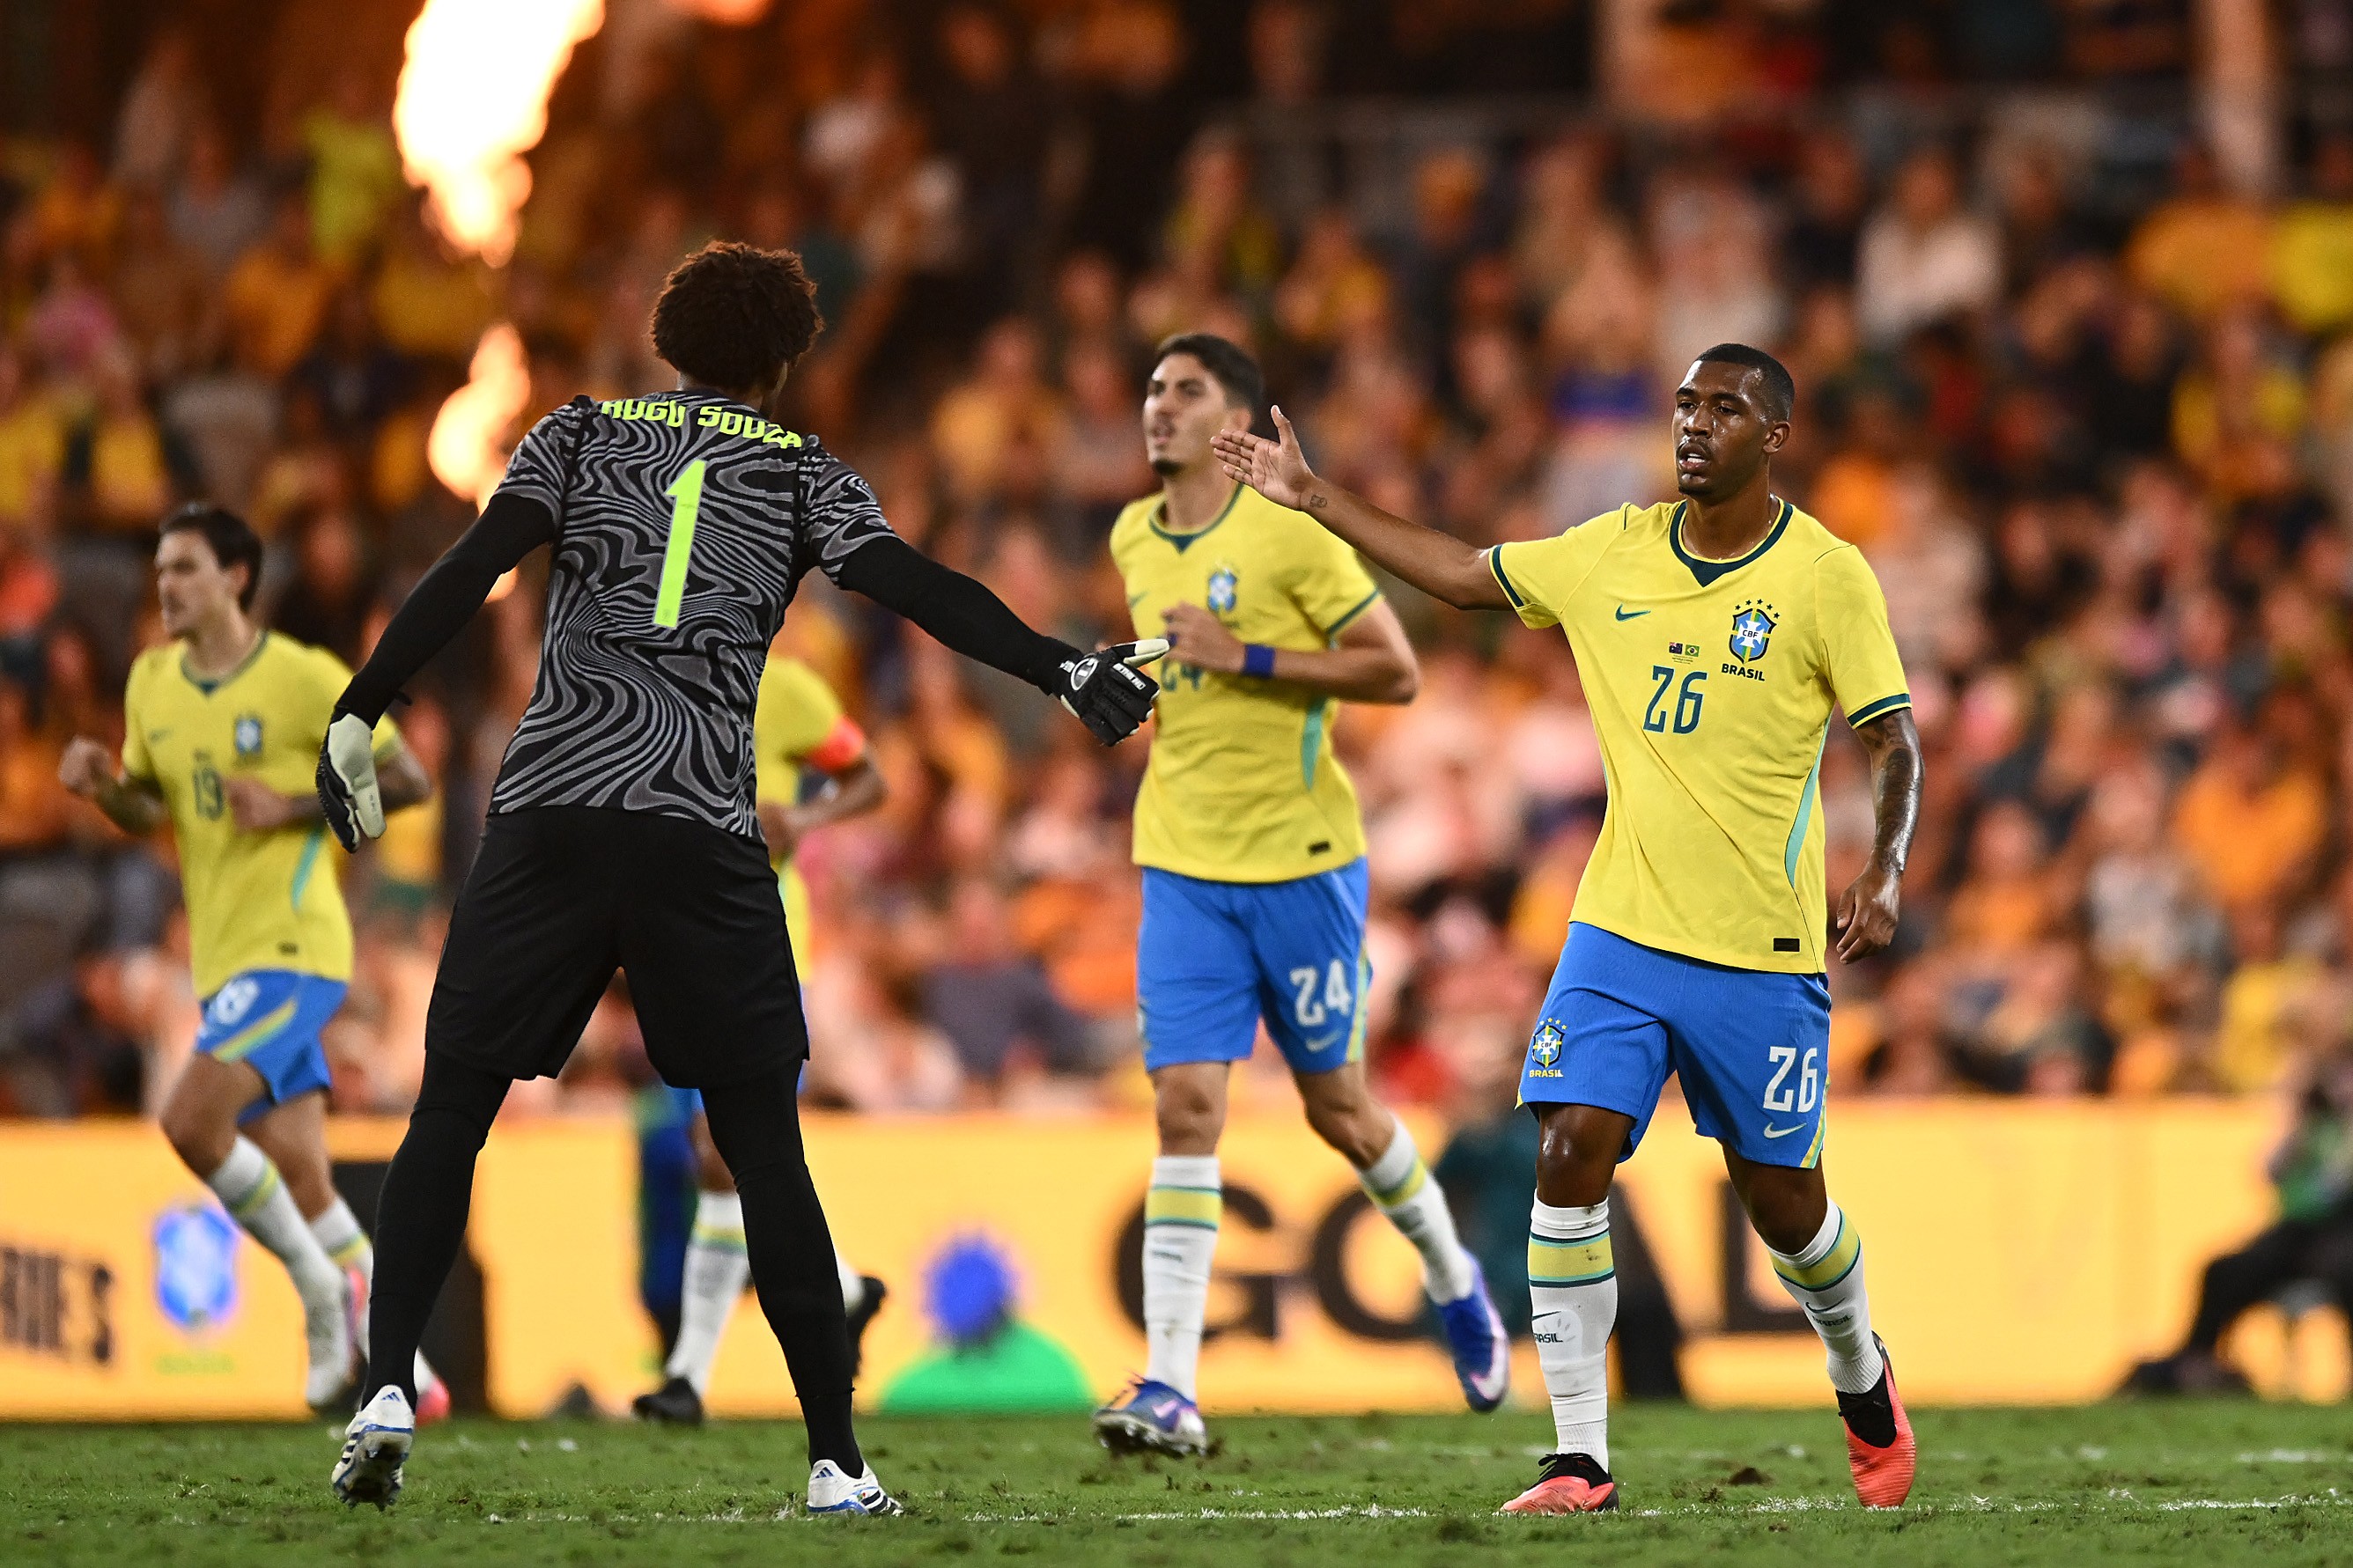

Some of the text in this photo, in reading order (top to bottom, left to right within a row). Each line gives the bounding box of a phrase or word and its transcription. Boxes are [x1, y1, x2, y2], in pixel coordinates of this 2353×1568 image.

[601, 399, 802, 449] HUGO SOUZA
[653, 459, 707, 629] 1
[1742, 629, 1759, 638] CBF
[1642, 665, 1708, 734] 26
[1722, 663, 1765, 681] BRASIL
[1289, 959, 1353, 1027] 24
[1530, 1069, 1563, 1078] BRASIL
[1763, 1046, 1818, 1113] 26
